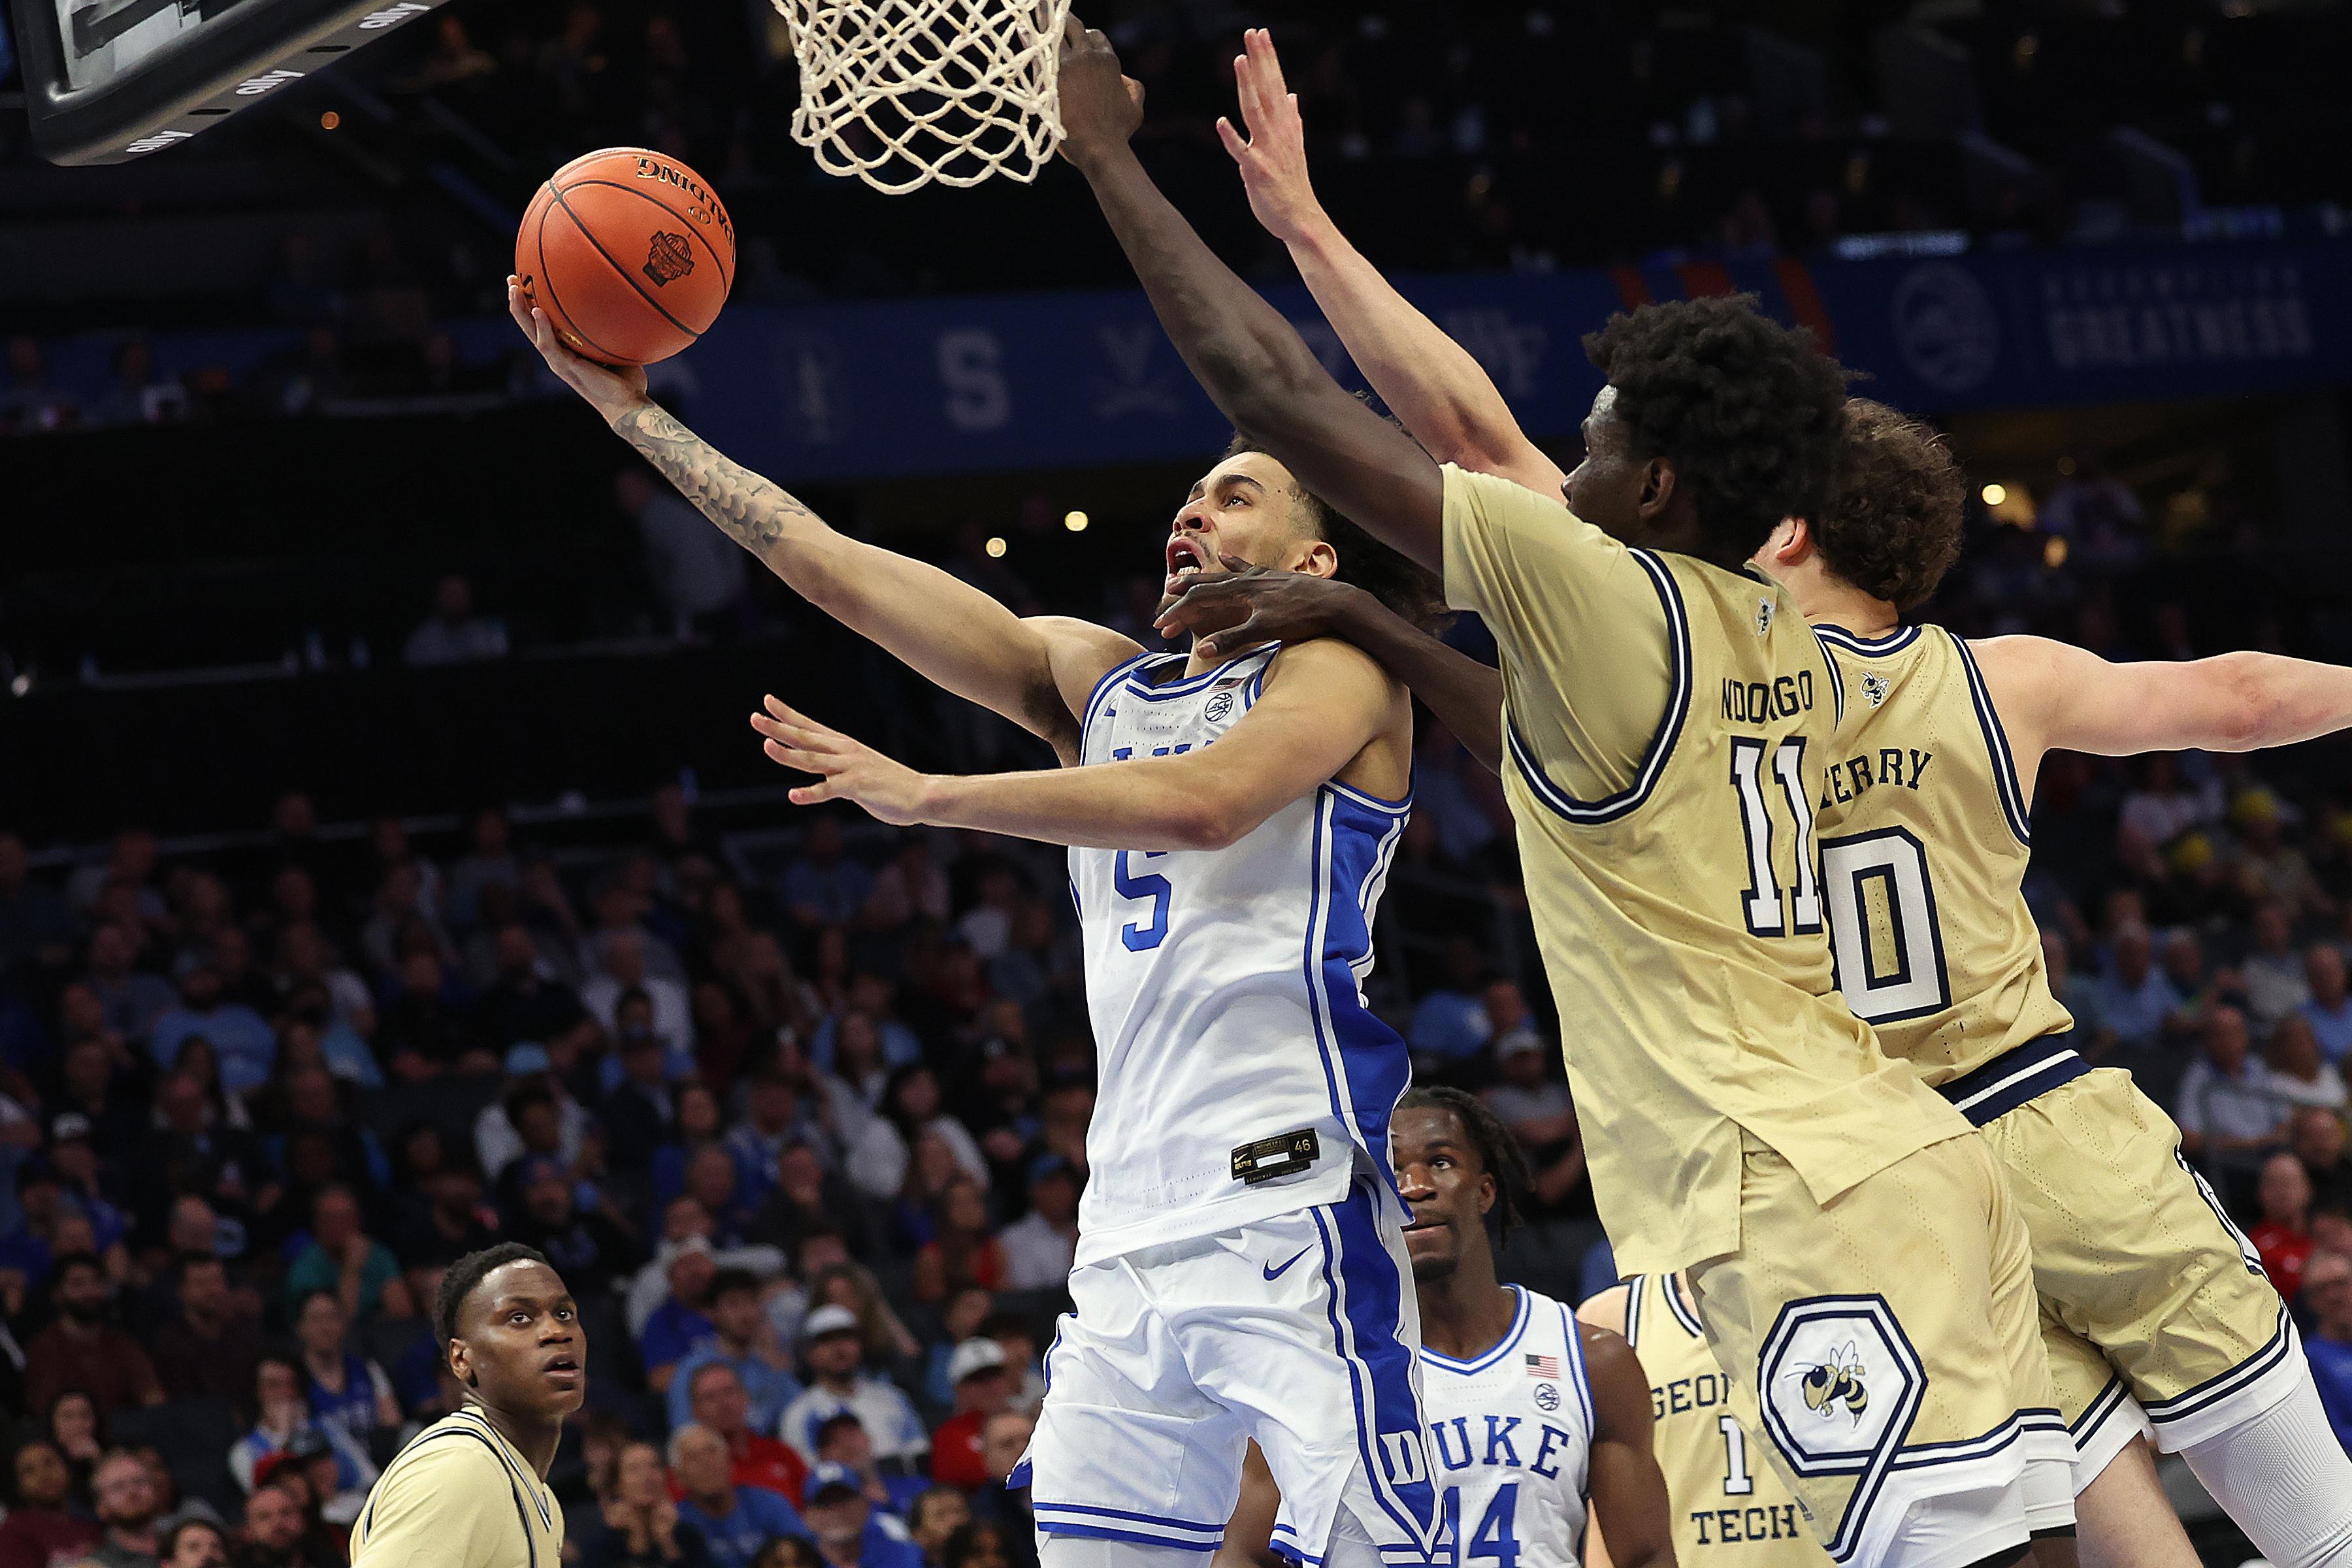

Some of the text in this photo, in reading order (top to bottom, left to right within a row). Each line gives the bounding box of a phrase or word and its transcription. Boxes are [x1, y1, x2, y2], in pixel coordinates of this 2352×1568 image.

[358, 2, 431, 29] ally
[235, 69, 306, 95] ally
[125, 130, 195, 153] ally
[1730, 735, 1824, 938] 11
[1114, 851, 1171, 952] 5
[1818, 825, 1953, 1025] 0
[1294, 1139, 1311, 1153] 46
[1431, 1414, 1570, 1480] UKE
[1719, 1415, 1754, 1496] 1
[1443, 1482, 1521, 1568] 14
[1691, 1505, 1799, 1545] TECH
